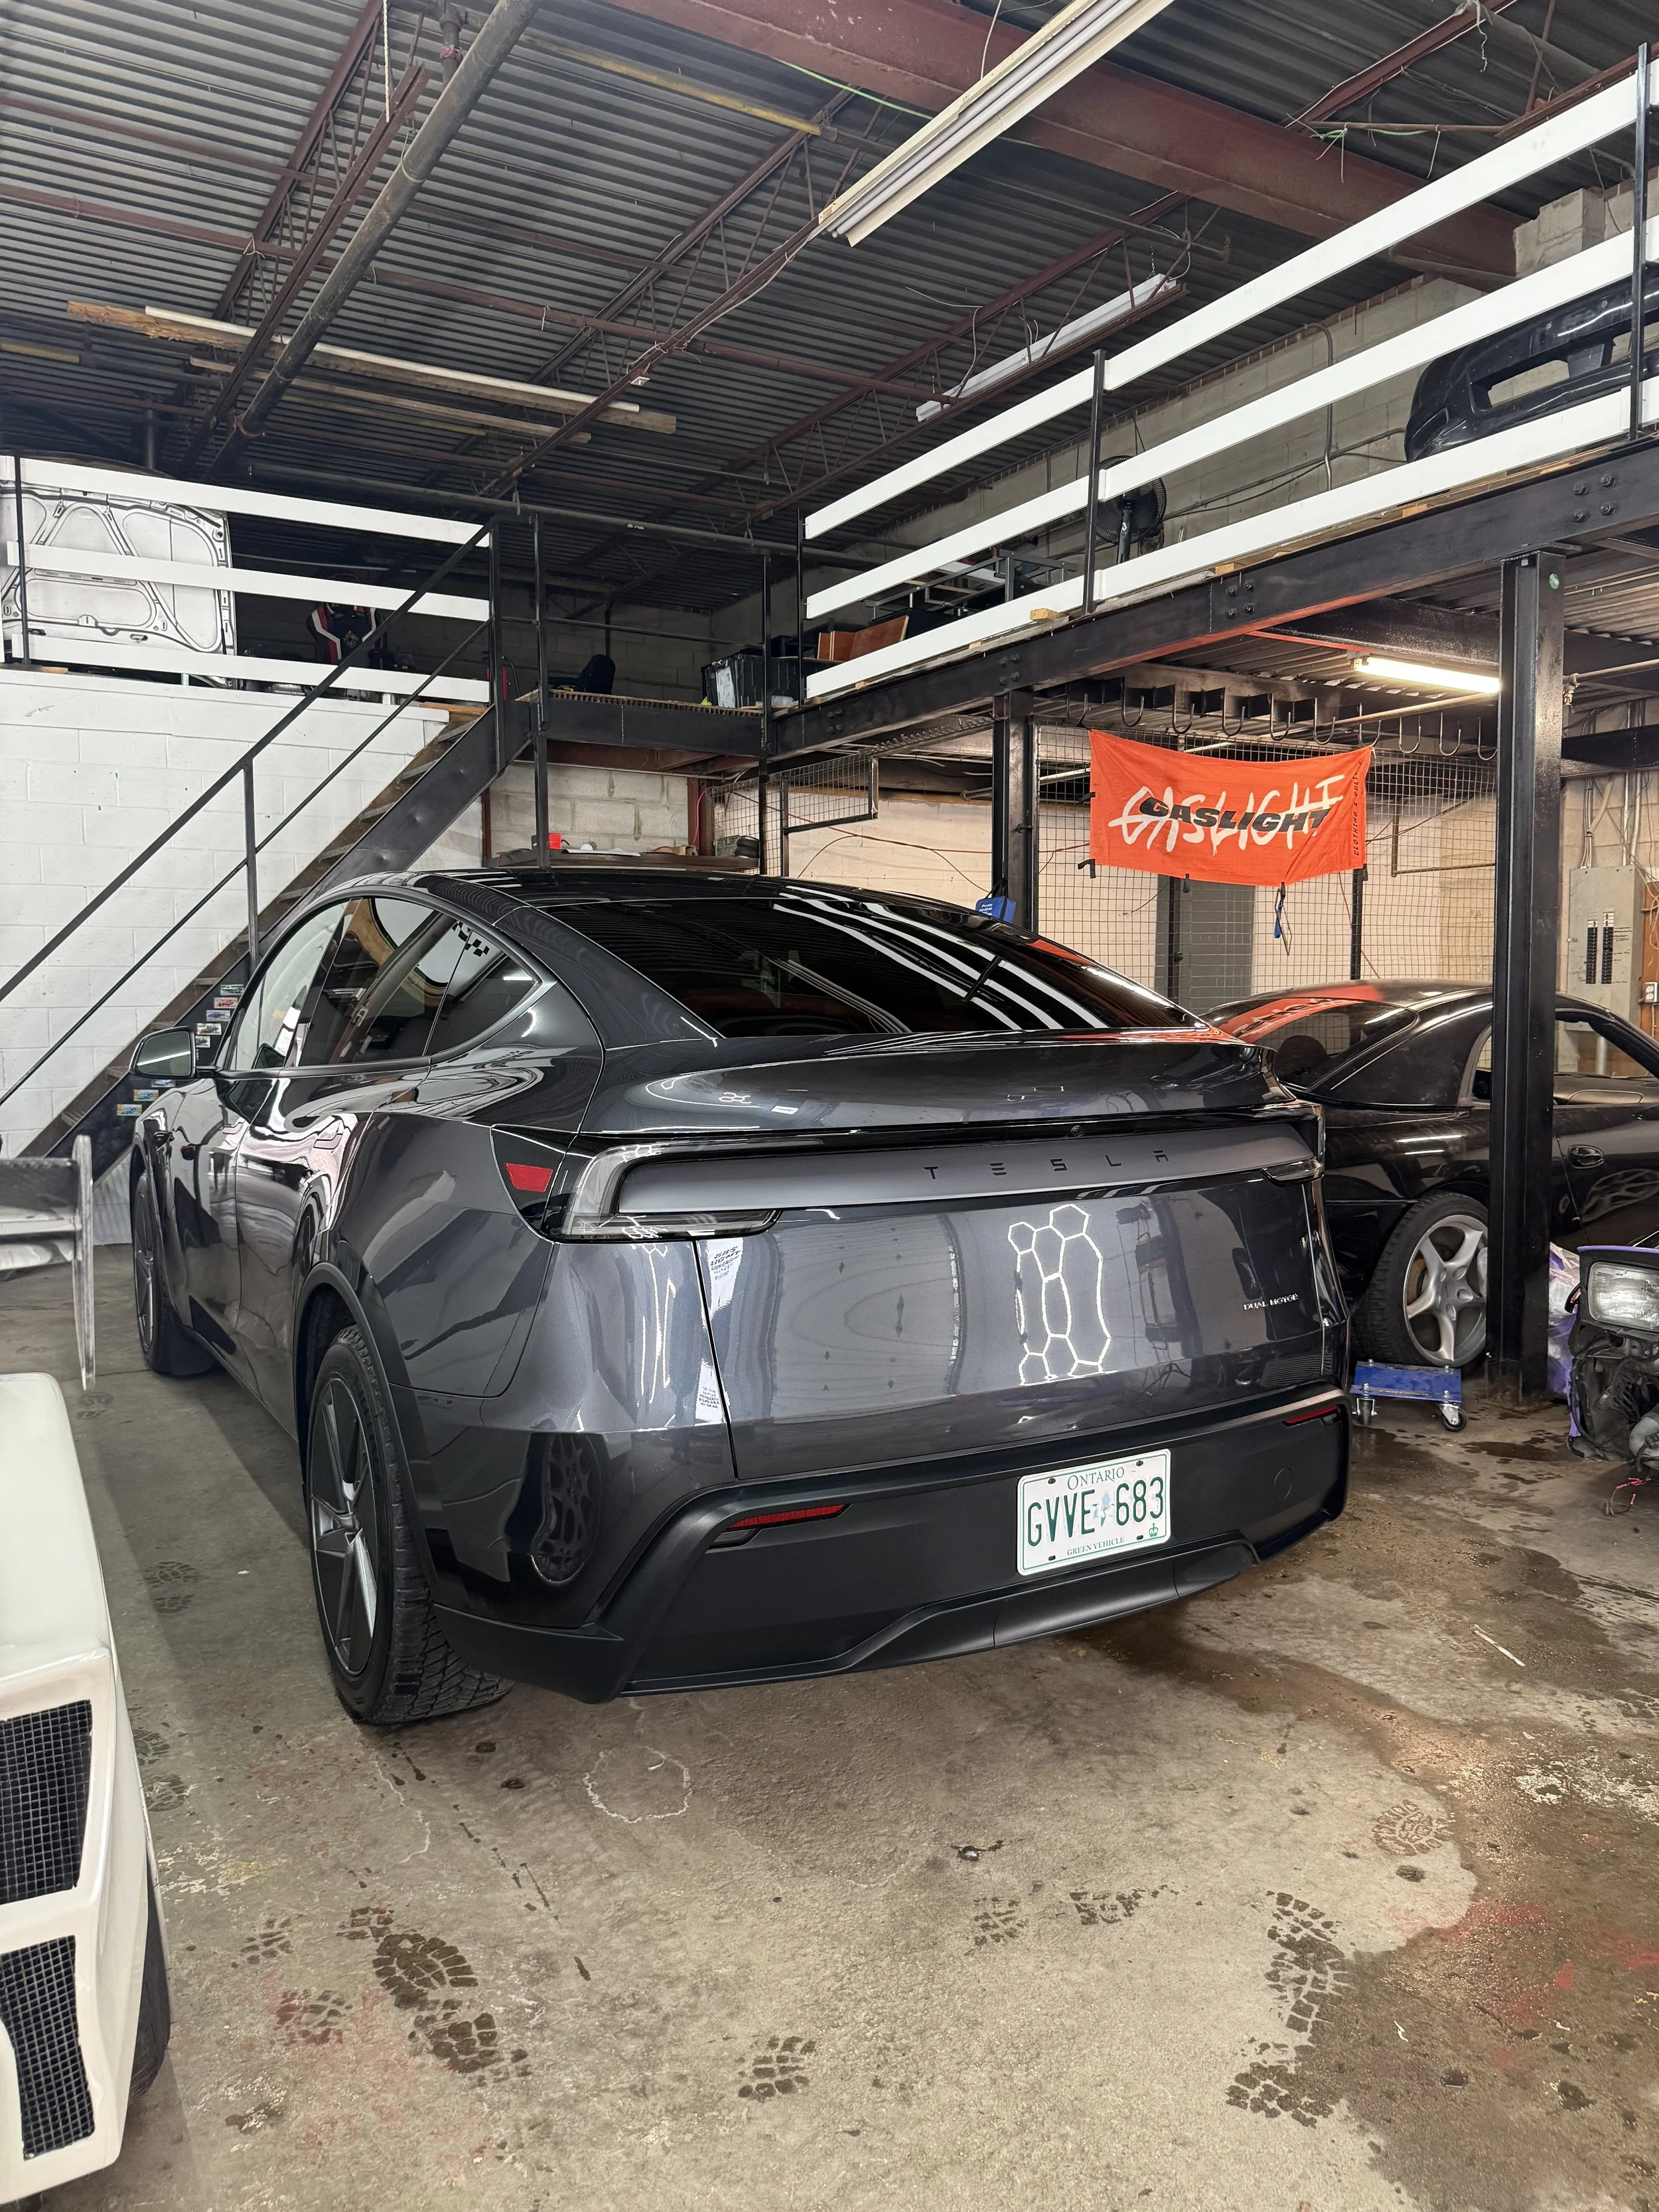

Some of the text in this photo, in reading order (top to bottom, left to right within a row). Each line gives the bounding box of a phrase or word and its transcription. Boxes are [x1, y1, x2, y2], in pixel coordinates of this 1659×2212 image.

[1108, 774, 1346, 856] GASLIGHT
[1139, 796, 1331, 832] GASLIGHT
[923, 1150, 1169, 1180] TESLA
[1243, 1293, 1299, 1311] DUAL MOTOR
[1067, 1467, 1125, 1491] ONTARIO
[1028, 1476, 1163, 1548] GVVE 683
[1067, 1536, 1125, 1556] GREEN VEHICLE
